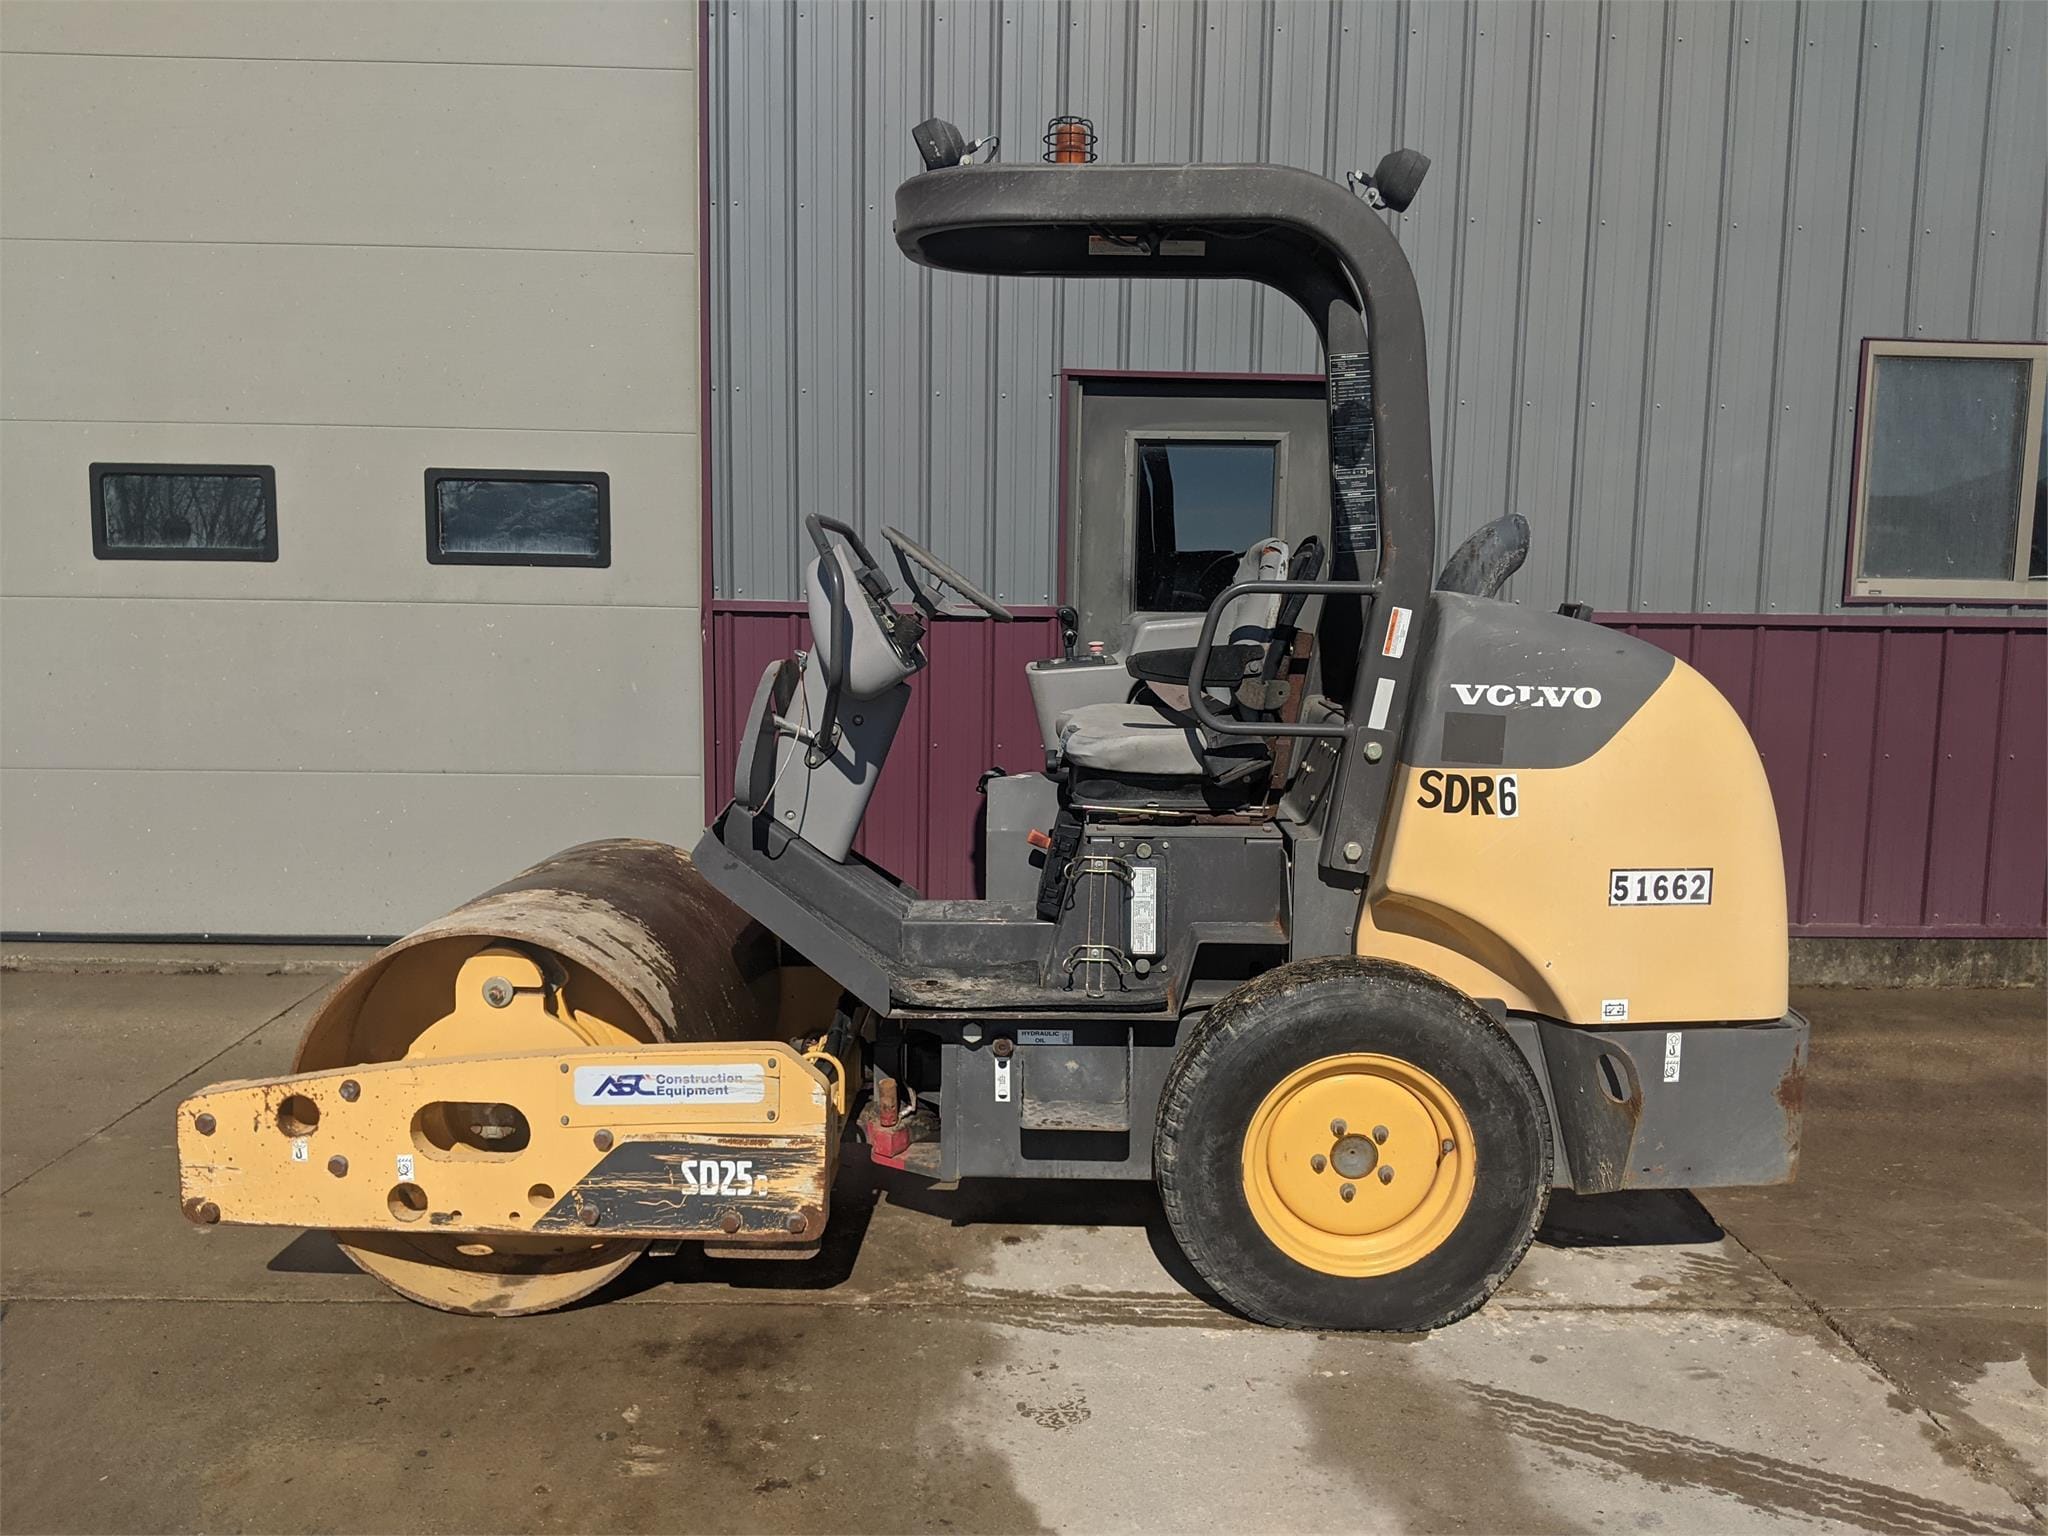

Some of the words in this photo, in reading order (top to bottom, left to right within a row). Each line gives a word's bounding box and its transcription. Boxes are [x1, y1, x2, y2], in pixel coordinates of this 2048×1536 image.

[1450, 684, 1602, 709] VOLVO
[1417, 769, 1517, 816] SDR6
[1613, 874, 1706, 901] 51662
[656, 1073, 743, 1085] Construction
[656, 1085, 729, 1098] Equipment
